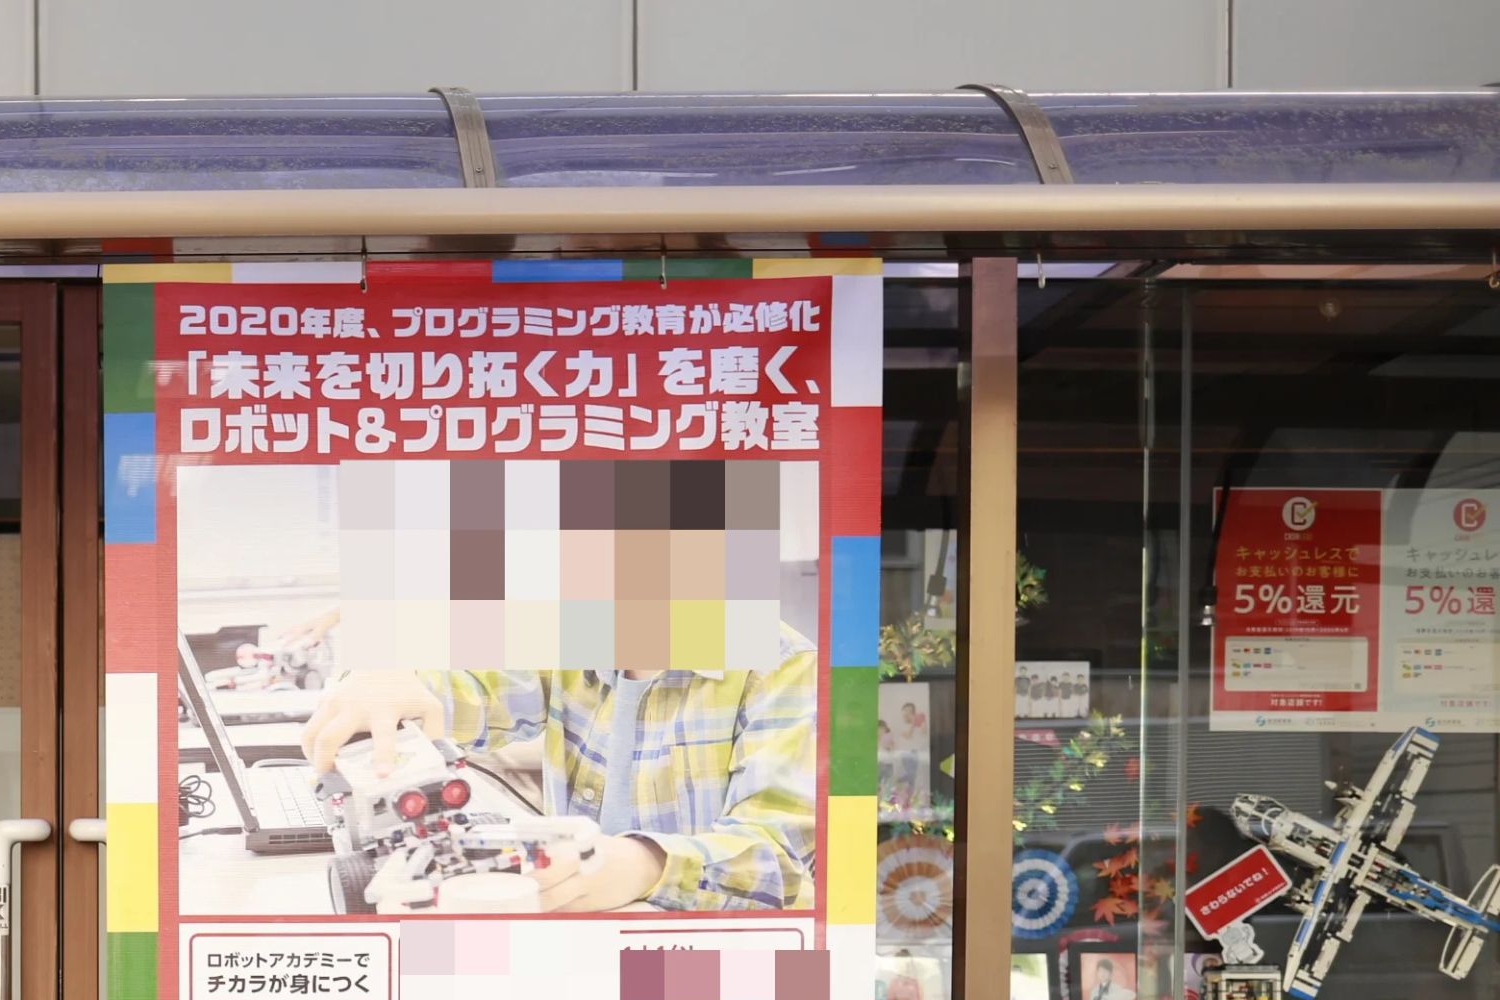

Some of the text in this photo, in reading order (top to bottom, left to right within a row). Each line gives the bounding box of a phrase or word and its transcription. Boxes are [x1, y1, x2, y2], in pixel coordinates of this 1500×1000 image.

[179, 300, 821, 340] 2020年度、プログラミング教育が必修化
[188, 346, 821, 400] 「未来を切り拓く力」を磨く、
[180, 402, 821, 455] ロボット&プログラミング教室
[1235, 546, 1360, 561] キャッシュレスで
[1236, 565, 1359, 578] お支払いのお客様に
[1234, 583, 1360, 614] 5%還元
[206, 952, 370, 970] ロボットアカデミーで
[206, 974, 371, 995] チカラが身につく
